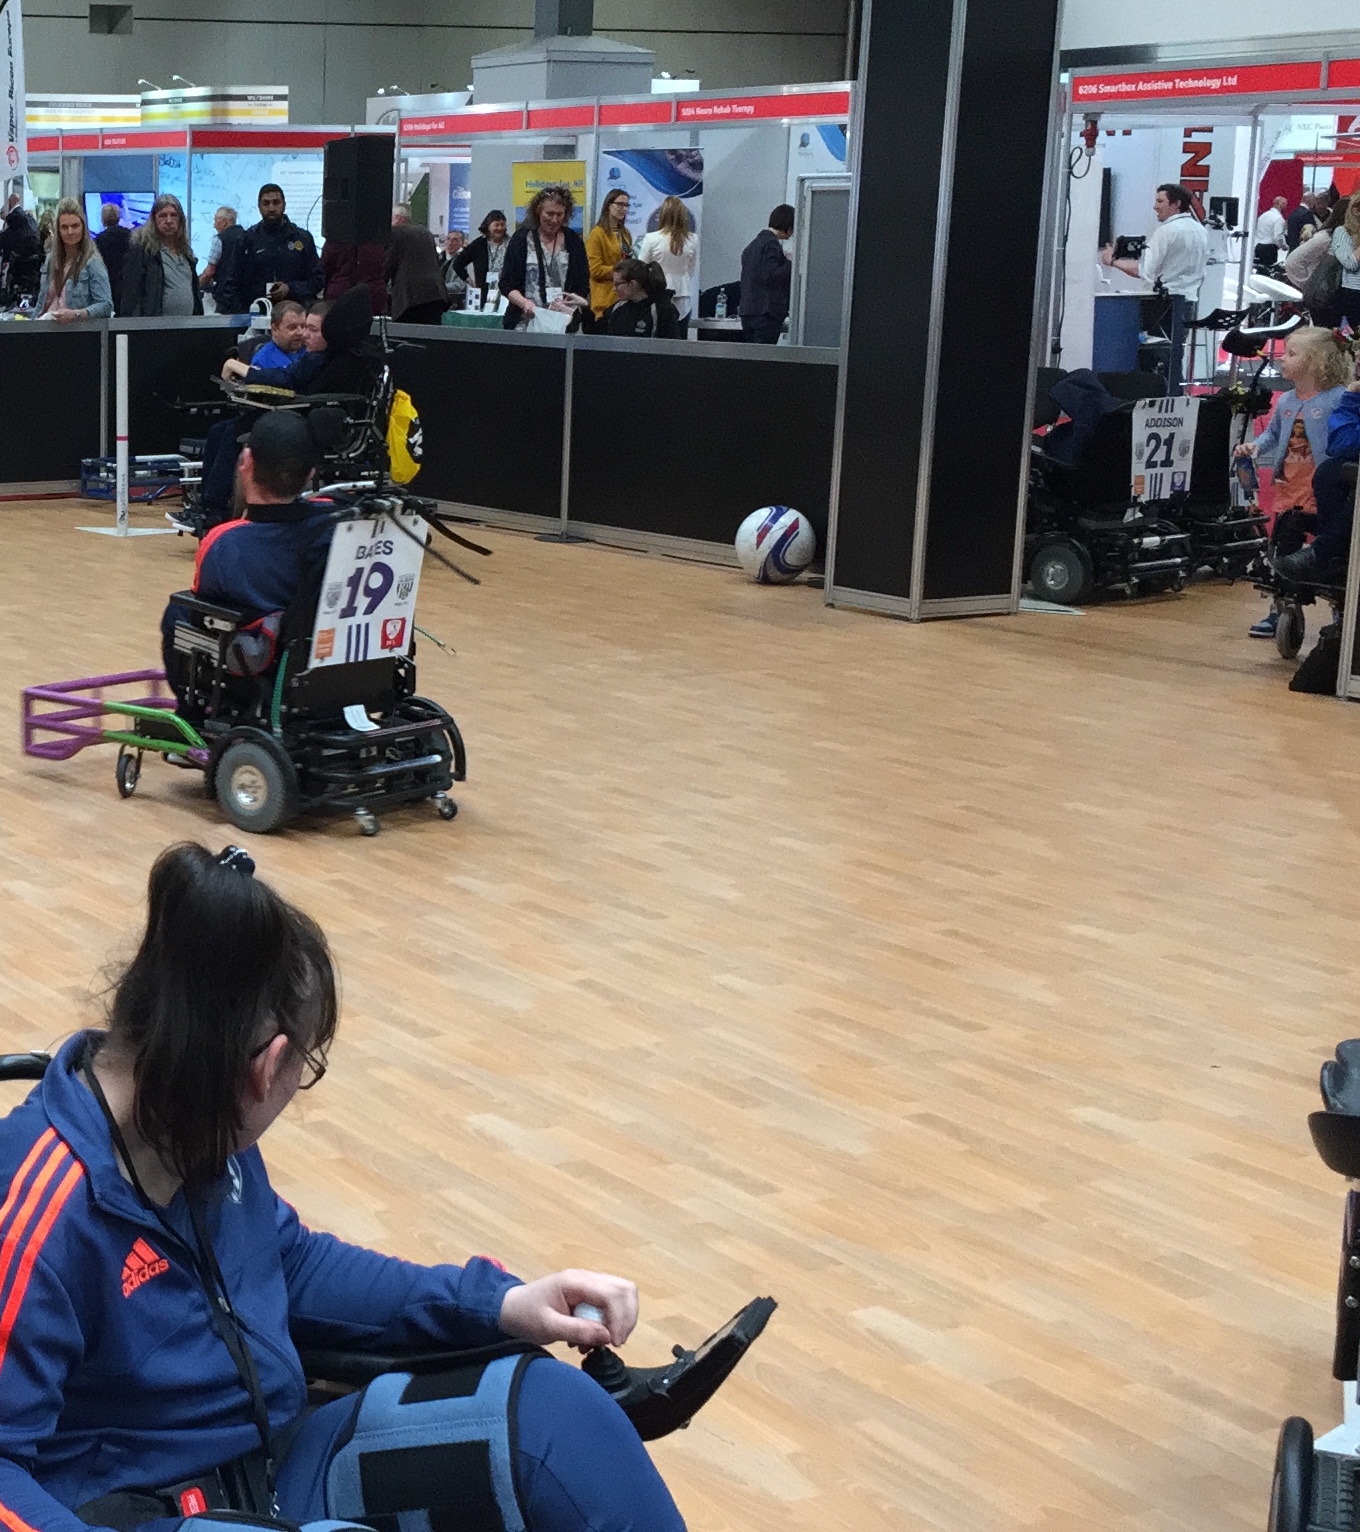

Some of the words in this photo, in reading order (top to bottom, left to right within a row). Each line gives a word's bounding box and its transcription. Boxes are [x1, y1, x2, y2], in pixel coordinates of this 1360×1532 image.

[1098, 81, 1136, 94] Smartbox
[1137, 79, 1173, 91] Assistive
[1174, 76, 1221, 90] Technology
[1222, 75, 1238, 86] Ltd
[1145, 417, 1184, 429] ADDISON
[1145, 432, 1175, 469] 21
[339, 561, 394, 619] 19
[122, 1259, 170, 1298] adidas
